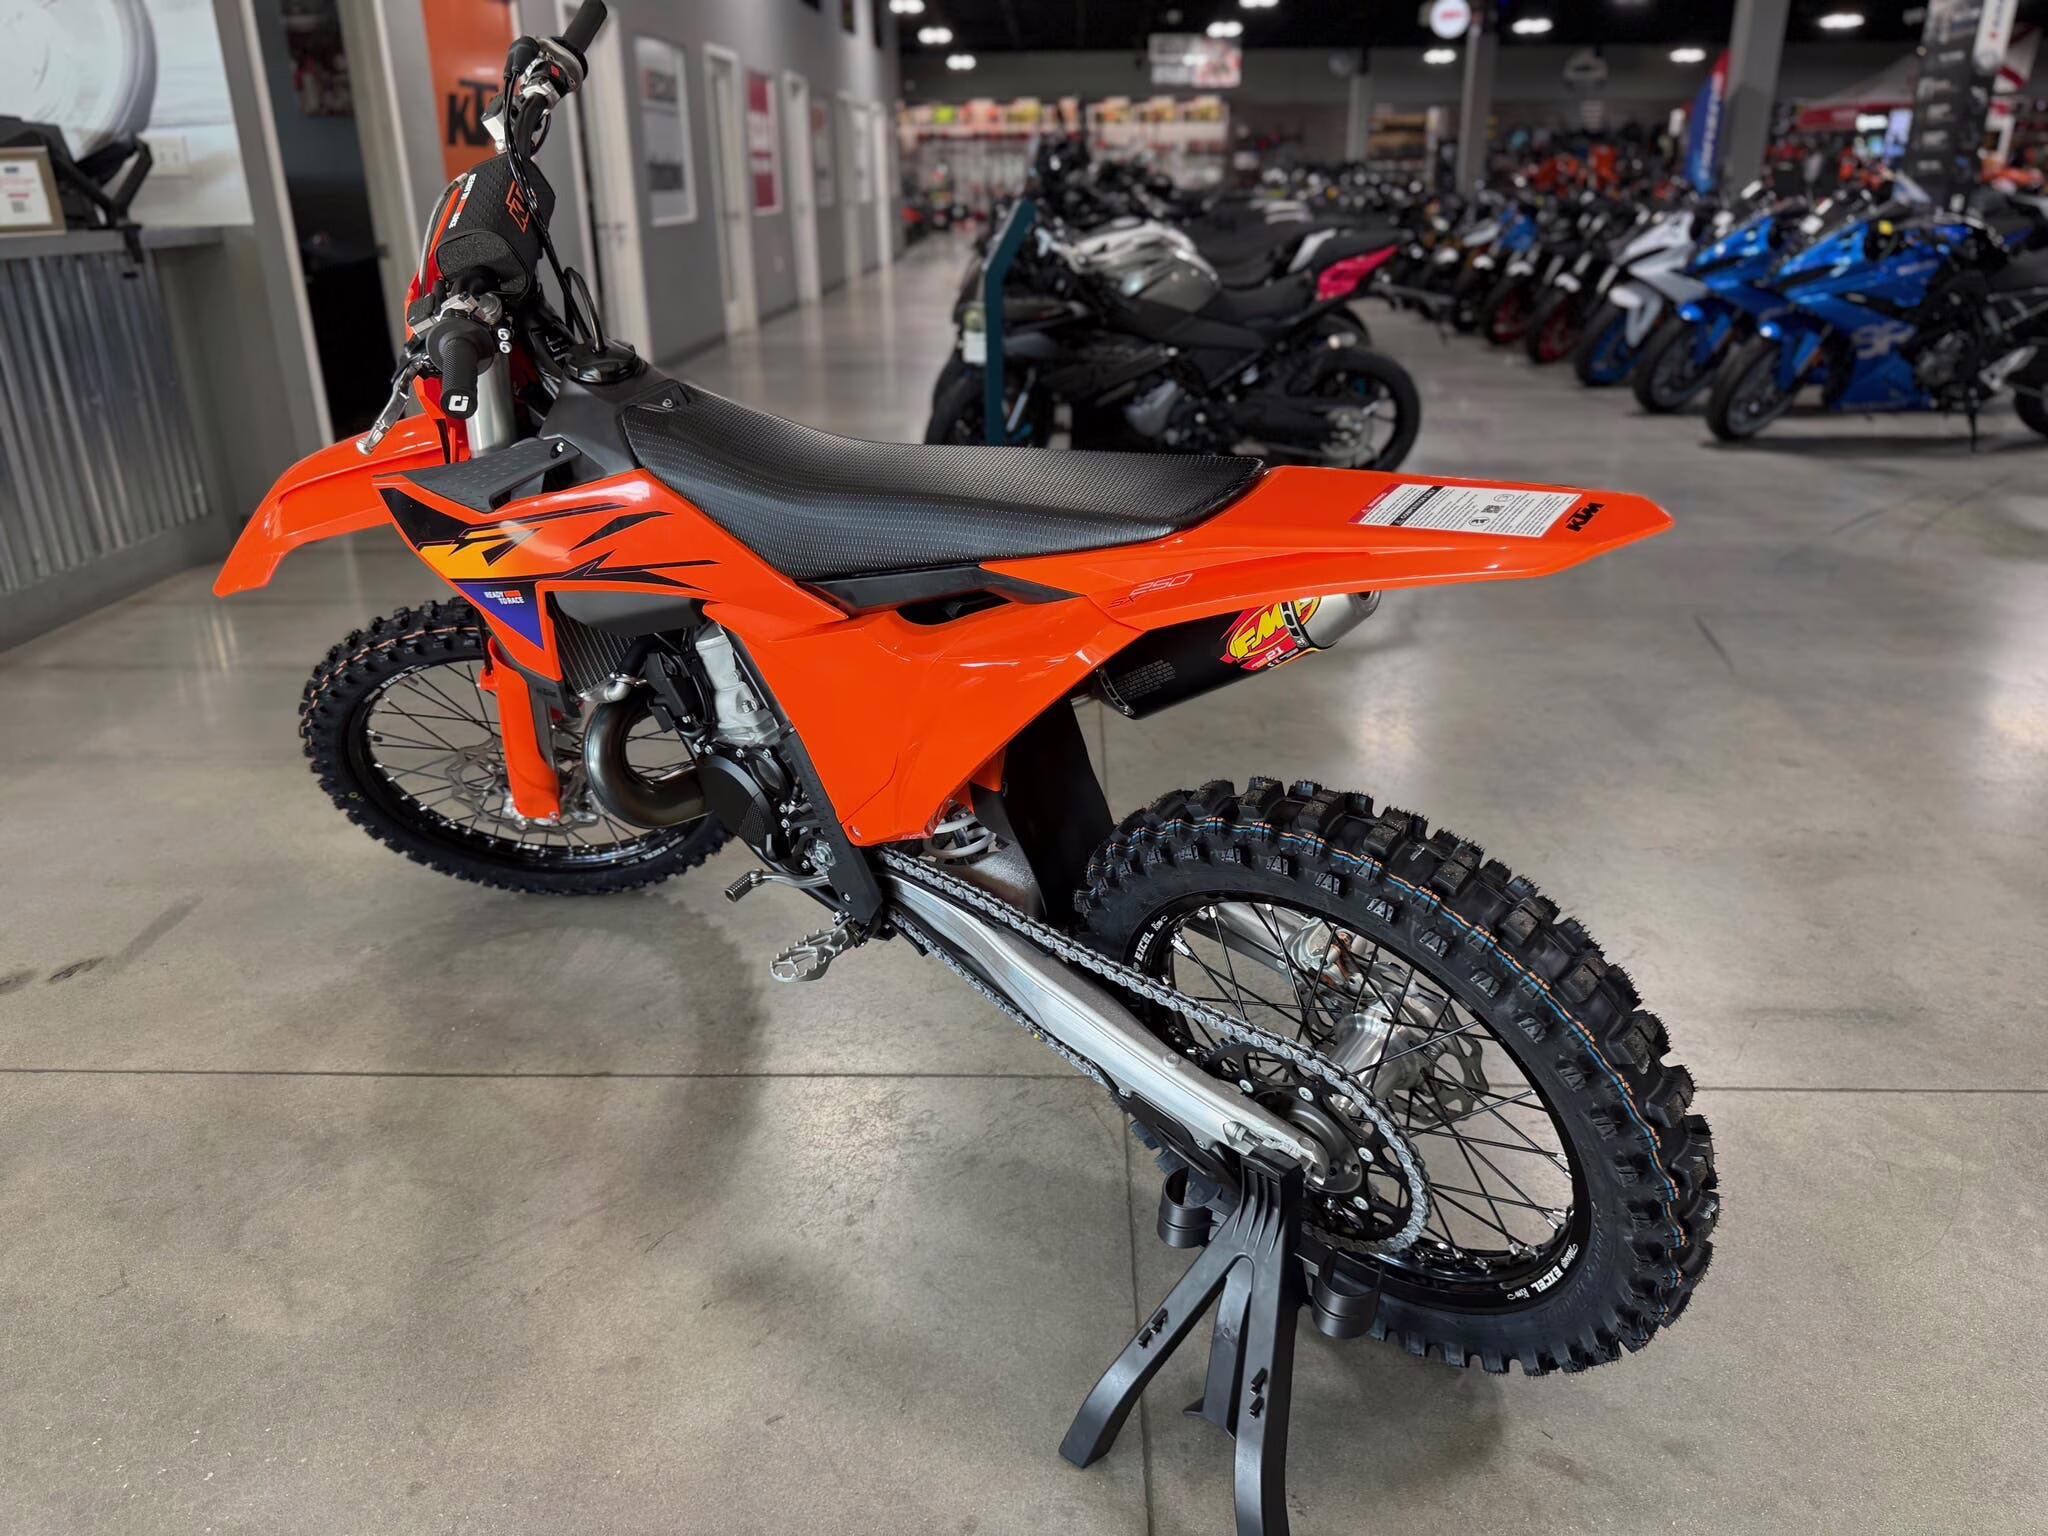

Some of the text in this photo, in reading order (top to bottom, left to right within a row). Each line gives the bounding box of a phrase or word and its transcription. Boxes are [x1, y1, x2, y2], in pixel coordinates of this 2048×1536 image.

[1565, 502, 1605, 533] KTM
[483, 591, 504, 599] READY
[1129, 573, 1193, 597] 250
[1134, 932, 1154, 961] EXCEL
[1530, 1265, 1564, 1293] EXCEL
